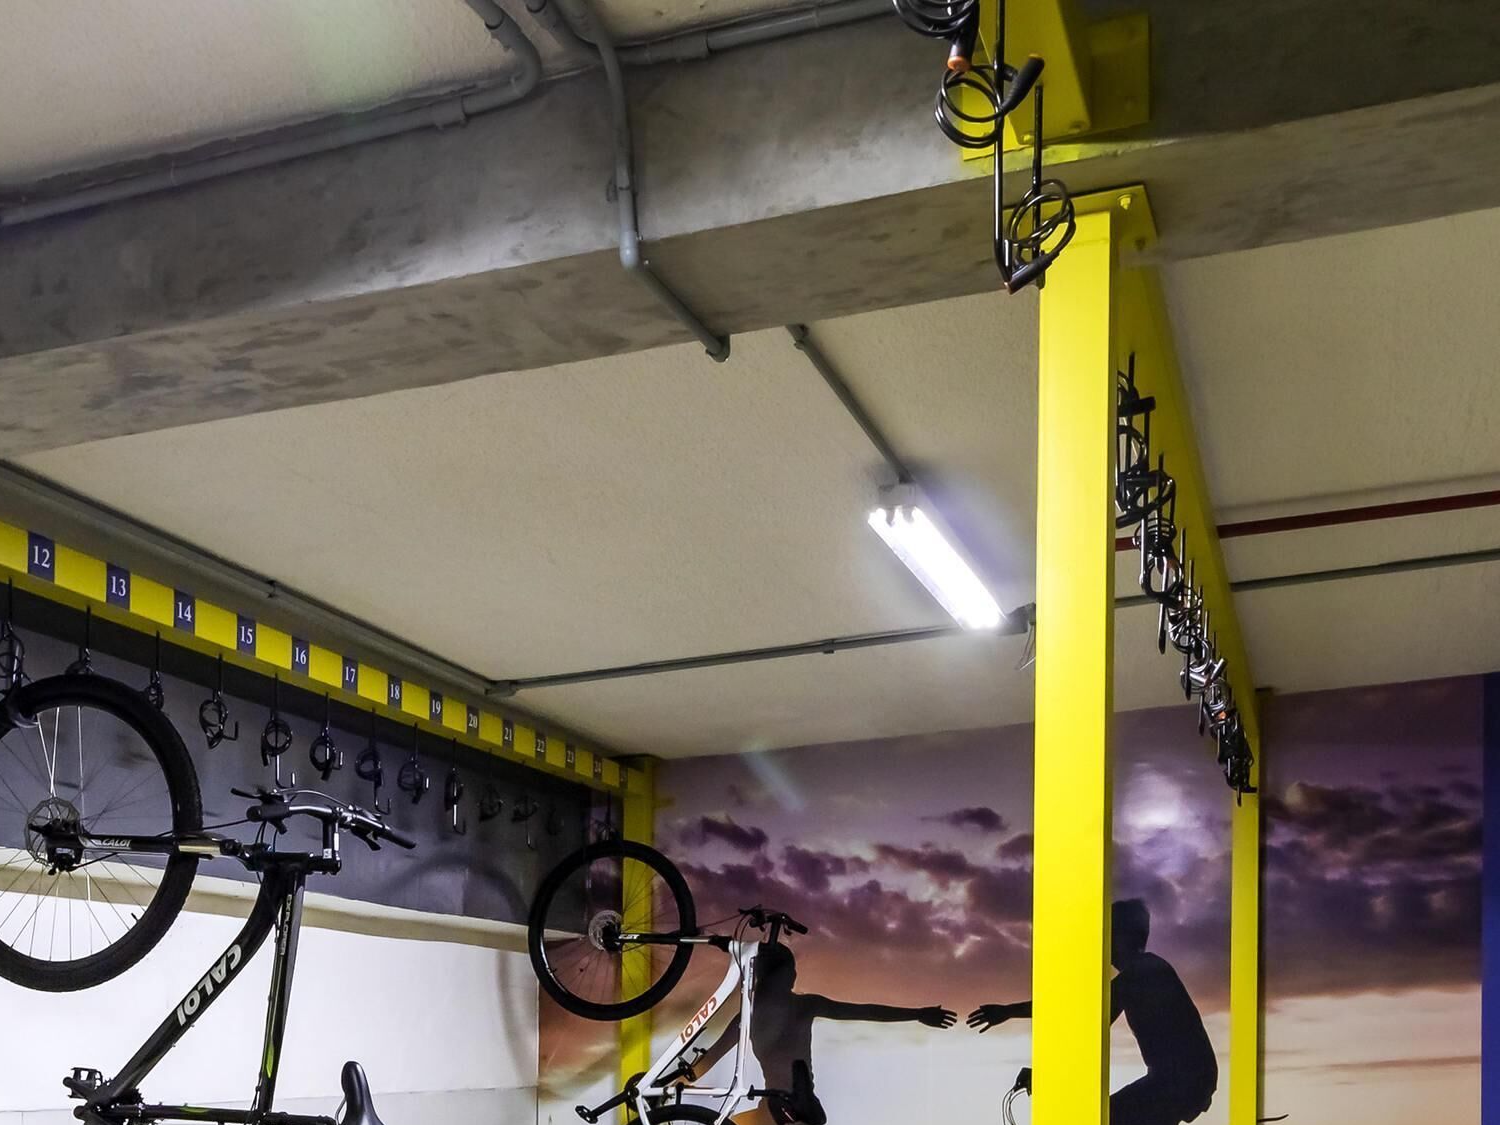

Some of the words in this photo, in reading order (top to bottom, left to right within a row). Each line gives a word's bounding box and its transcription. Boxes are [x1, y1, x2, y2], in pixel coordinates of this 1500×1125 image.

[33, 545, 50, 569] 12
[111, 575, 127, 597] 13
[177, 601, 193, 622] 14
[240, 625, 253, 644] 15
[295, 647, 308, 665] 16
[345, 666, 356, 683] 17
[390, 683, 401, 700] 18
[432, 699, 442, 715] 19
[468, 713, 478, 729] 20
[504, 727, 513, 742] 21
[102, 838, 132, 848] CALOI
[176, 944, 242, 1027] CALOI
[680, 996, 717, 1044] CALOI
